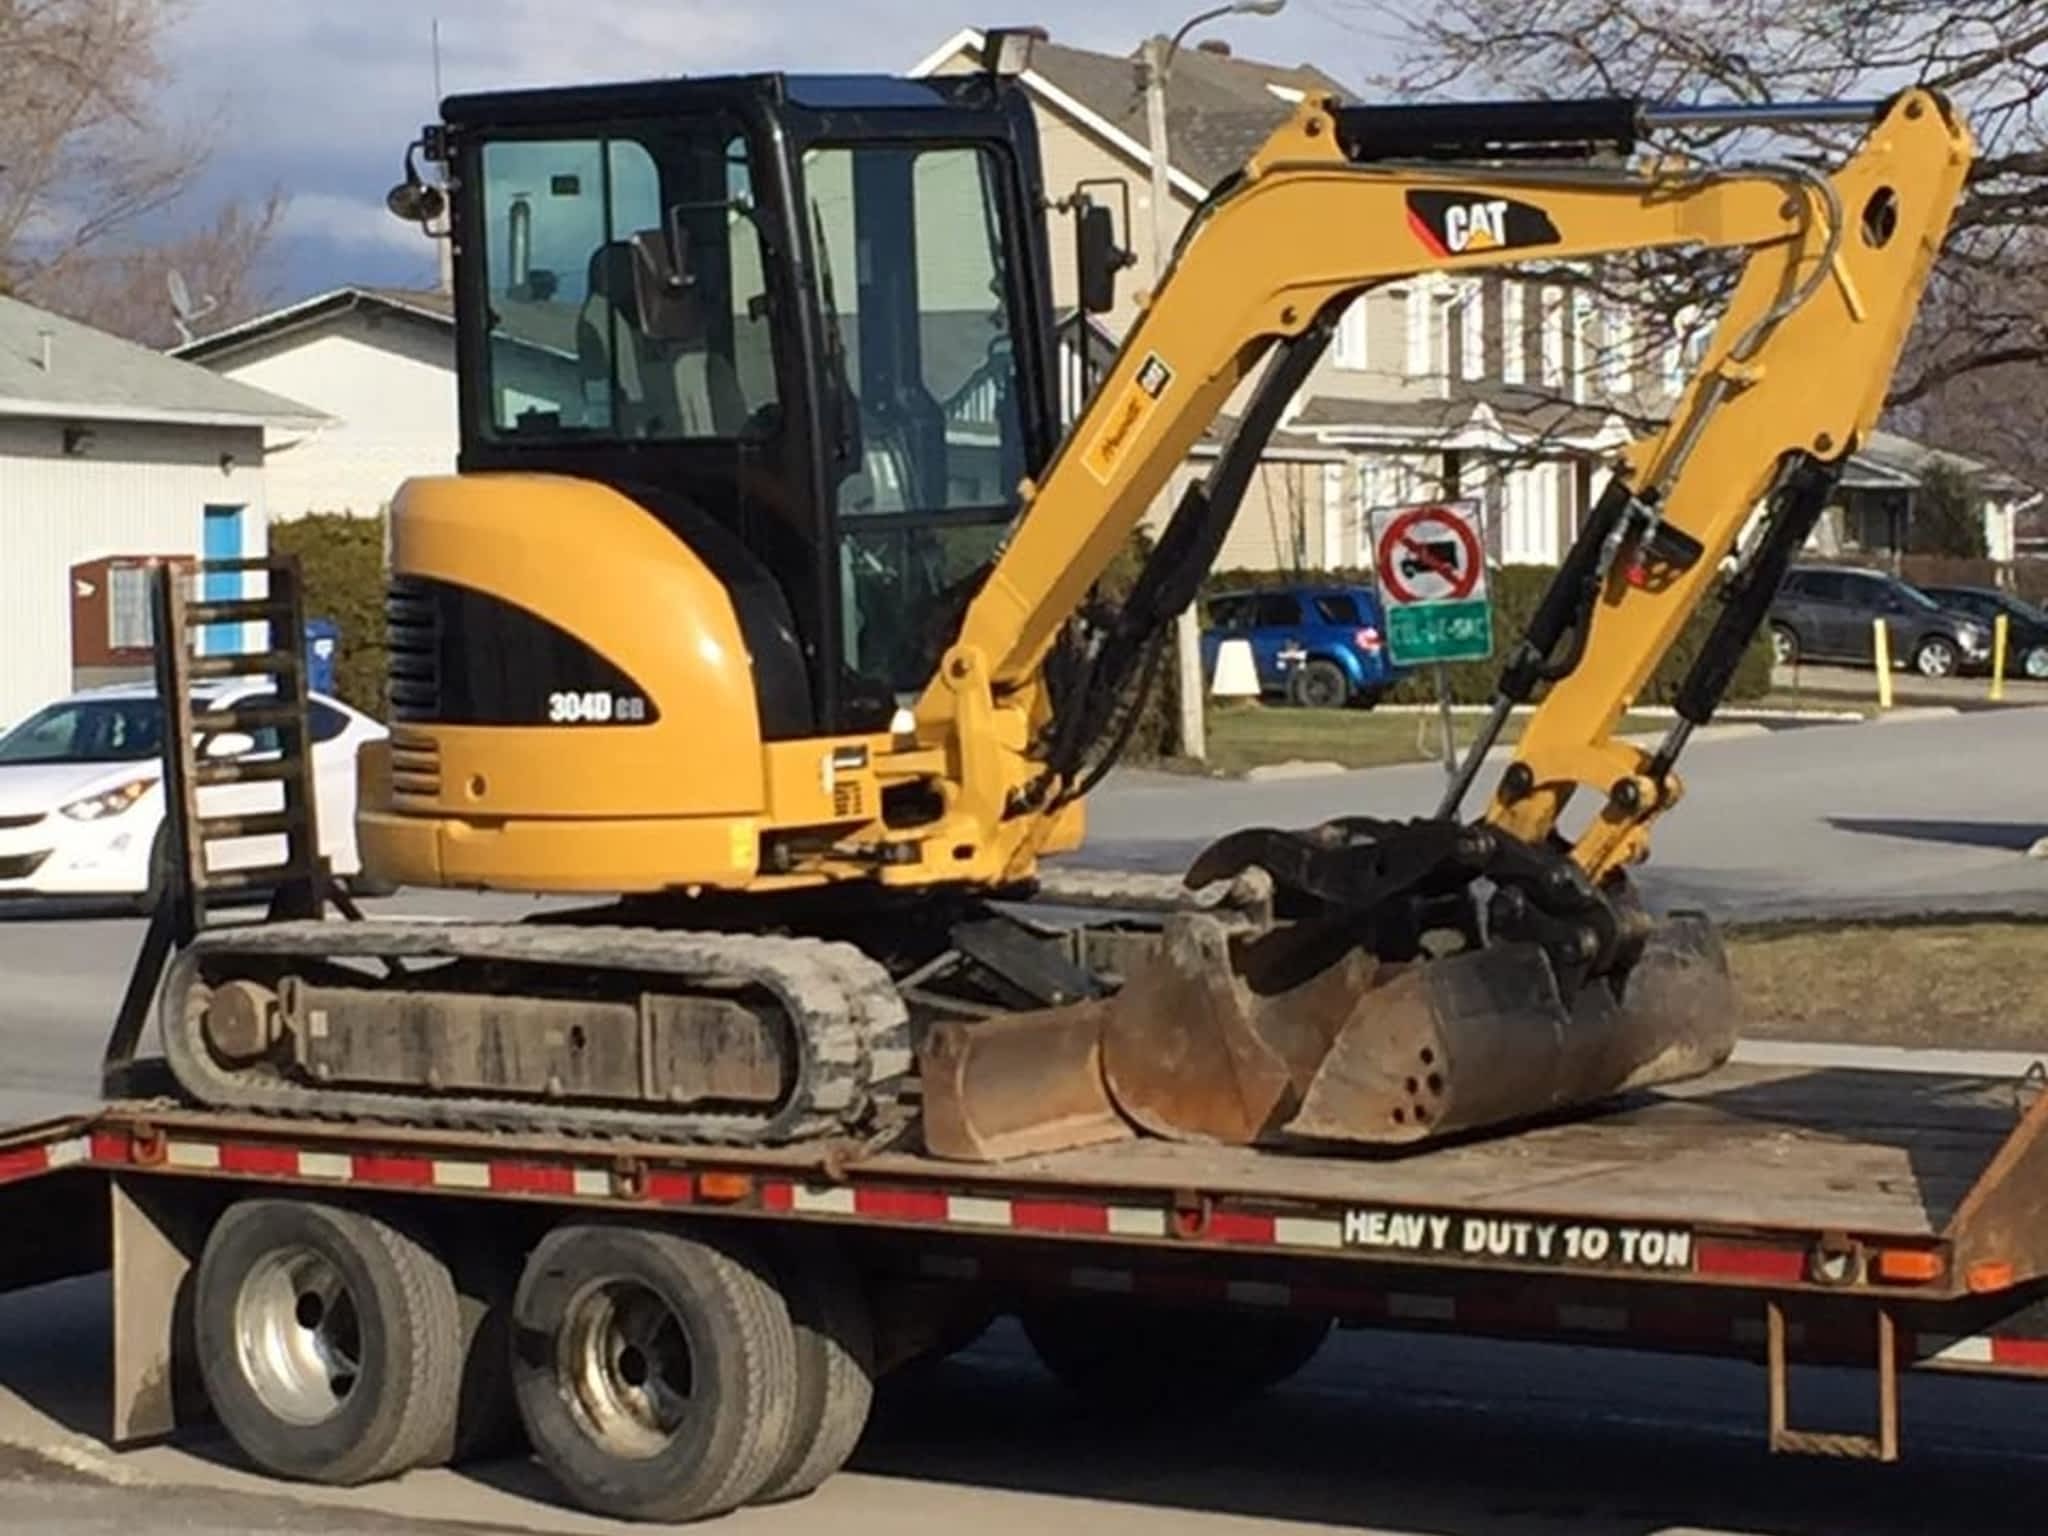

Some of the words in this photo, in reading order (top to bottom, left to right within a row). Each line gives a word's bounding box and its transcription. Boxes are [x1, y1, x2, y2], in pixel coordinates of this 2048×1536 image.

[1445, 201, 1508, 252] CAT
[549, 691, 612, 721] 304D
[1345, 1209, 1450, 1249] HEAVY
[1463, 1218, 1557, 1258] DUTY
[1563, 1225, 1610, 1260] 10
[1619, 1228, 1691, 1266] TON
